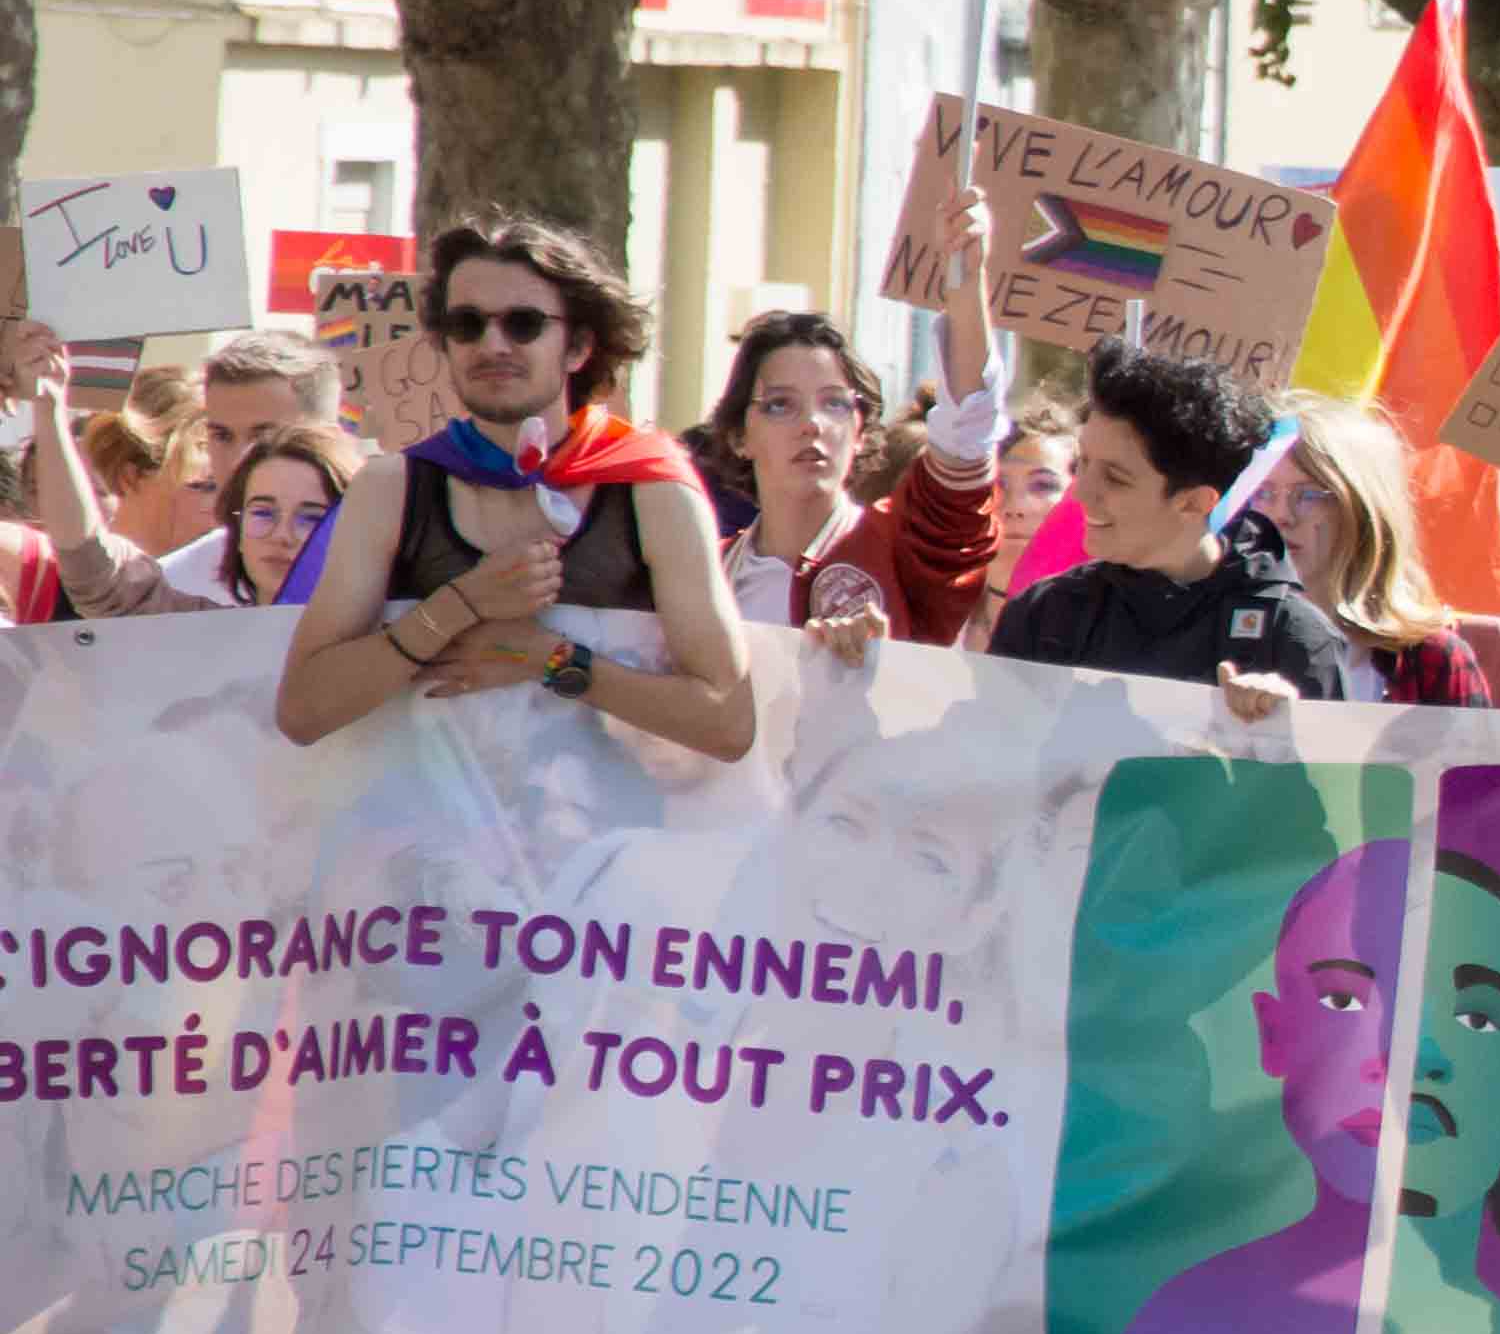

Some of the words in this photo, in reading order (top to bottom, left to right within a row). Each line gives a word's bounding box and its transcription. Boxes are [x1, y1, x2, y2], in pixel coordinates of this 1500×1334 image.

[936, 103, 1056, 178] VVE
[1067, 139, 1290, 245] L'AMOUR
[103, 225, 157, 270] LOVE
[165, 223, 207, 276] U
[890, 233, 1038, 319] NIE
[1040, 283, 1289, 391] ZEMOUR!
[0, 905, 448, 989] 'IGNORANCE
[471, 907, 631, 984] TON
[651, 925, 964, 1027] ENNEMI,
[230, 1013, 480, 1093] D'AIMER
[501, 1001, 557, 1088] À
[582, 1029, 786, 1109] TOUT
[809, 1053, 1010, 1128] PRIX.
[64, 1157, 262, 1219] MARCHE
[275, 1152, 345, 1204] DES
[350, 1143, 529, 1203] FIERTÉS
[544, 1162, 853, 1235] VENDÉENNE
[123, 1230, 278, 1293] SAMEDI
[288, 1224, 336, 1278] 24
[345, 1222, 616, 1289] SEPTEMBRE
[632, 1245, 785, 1306] 2022
